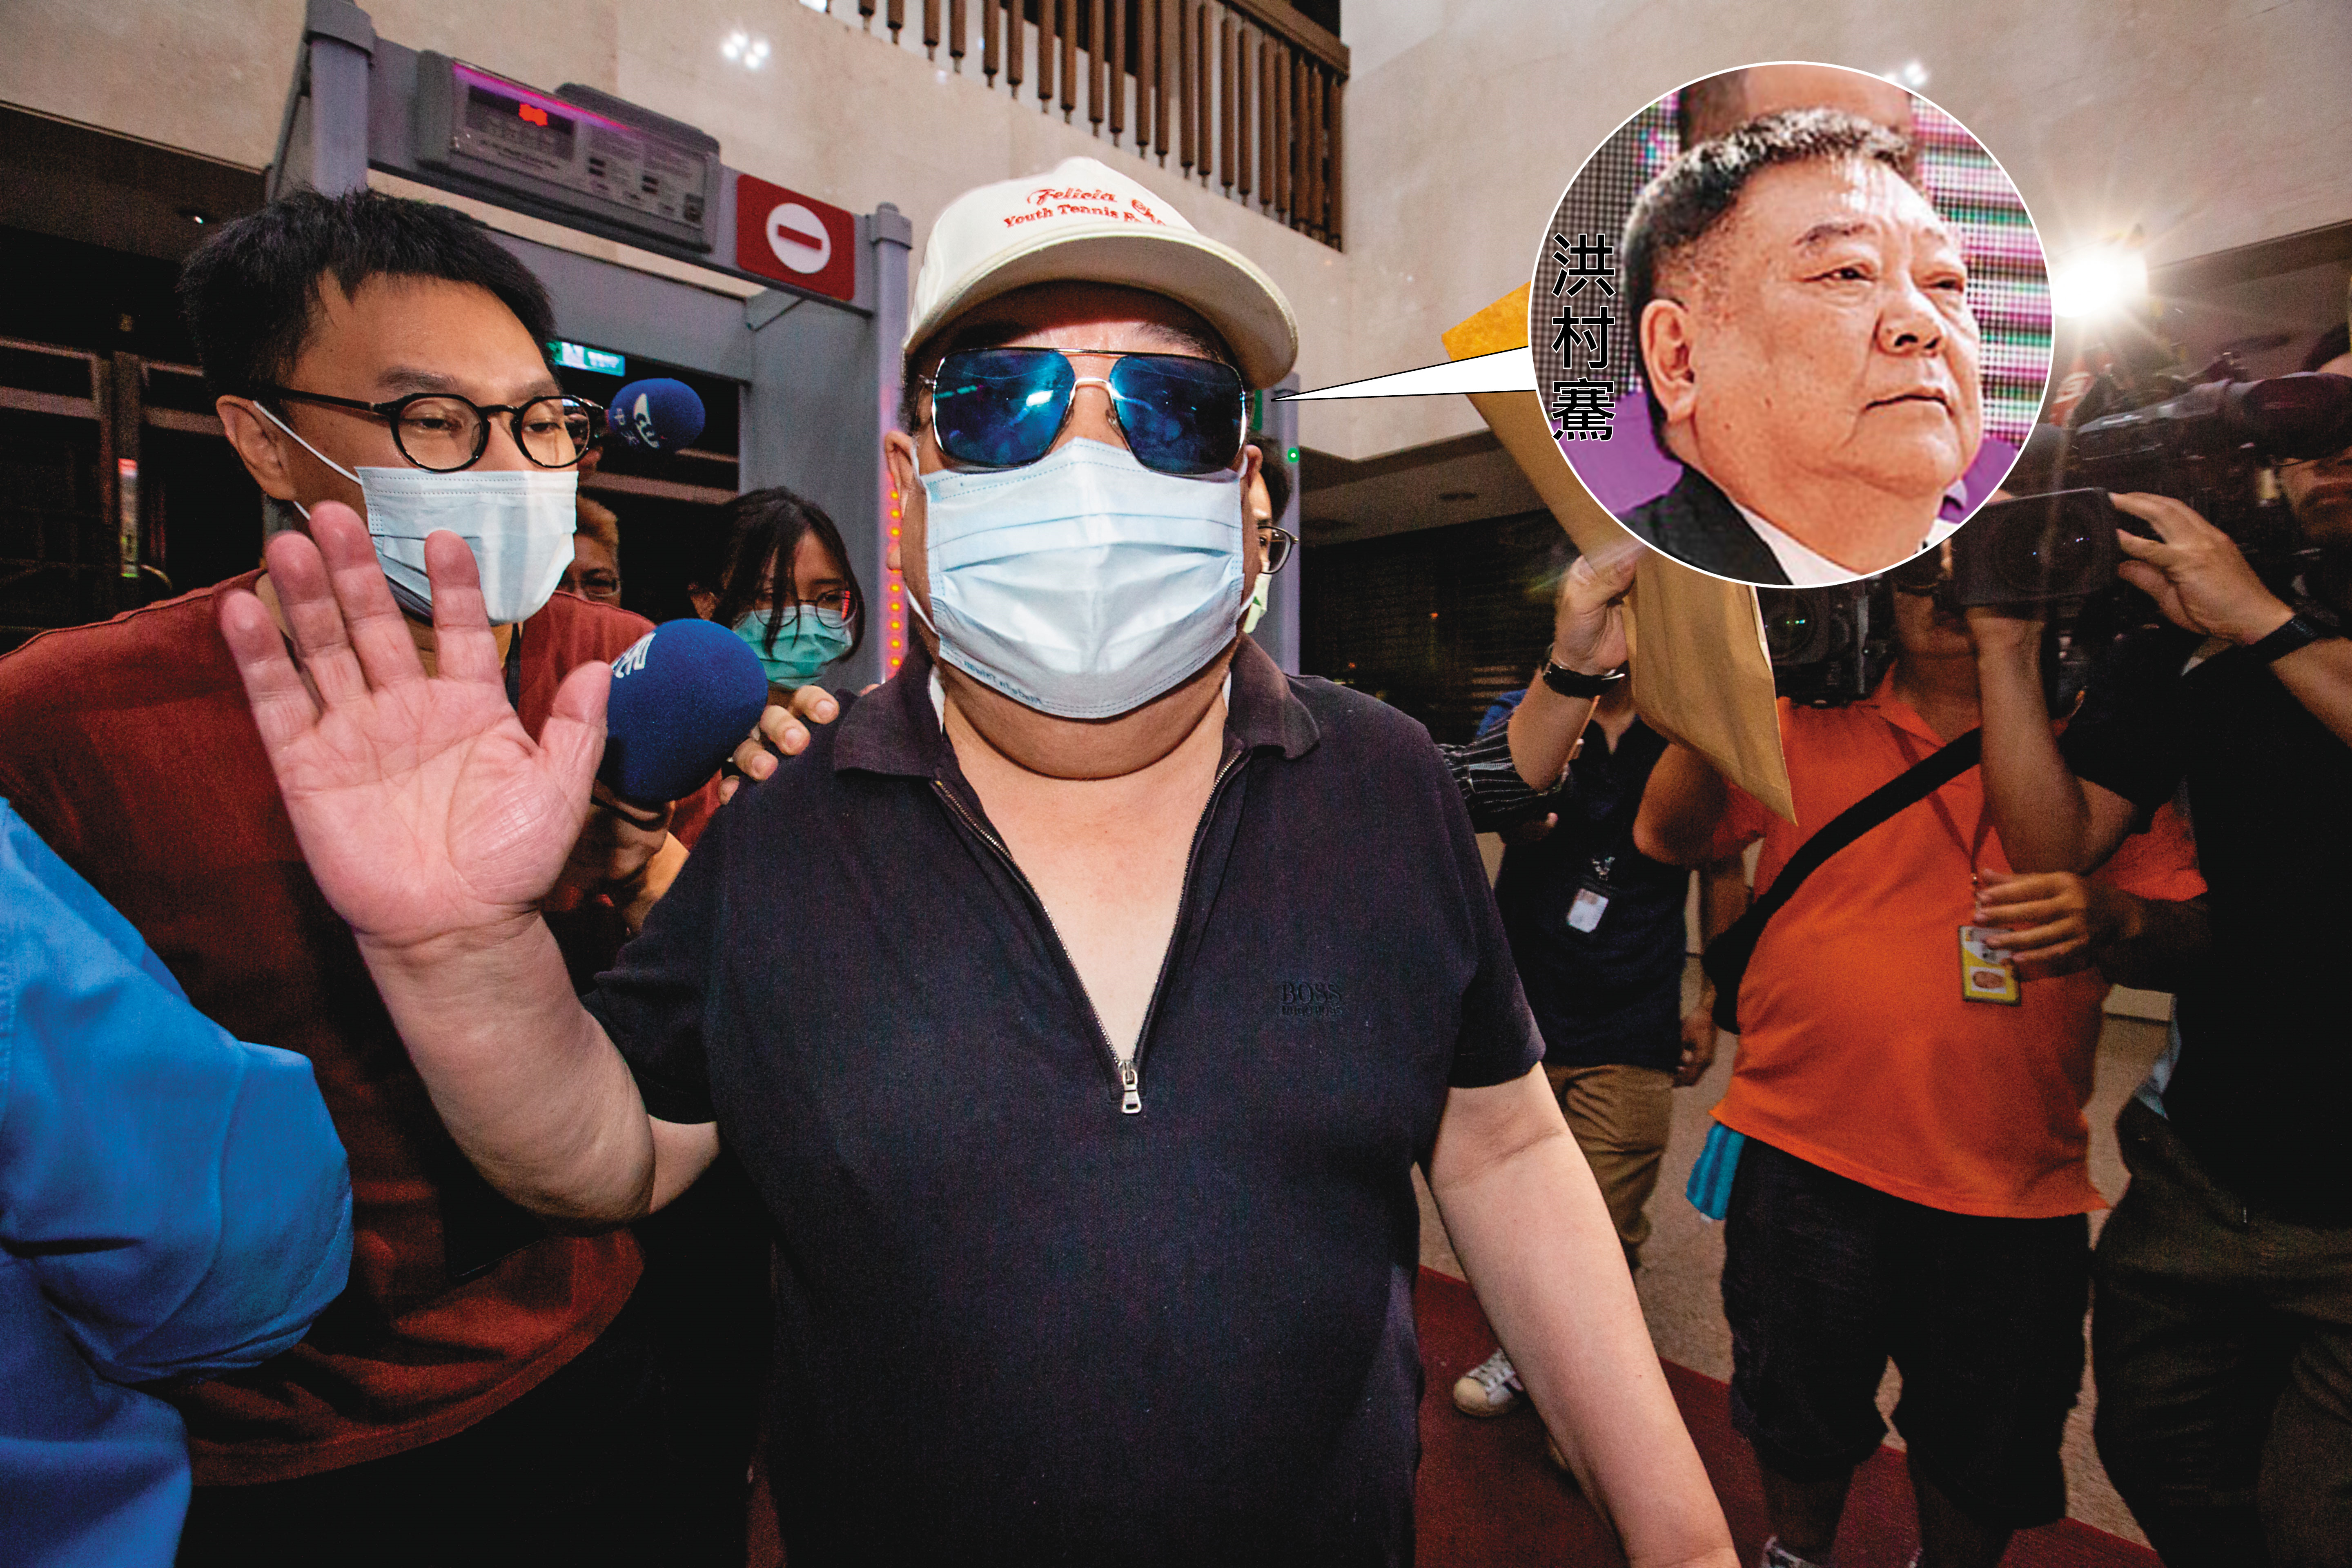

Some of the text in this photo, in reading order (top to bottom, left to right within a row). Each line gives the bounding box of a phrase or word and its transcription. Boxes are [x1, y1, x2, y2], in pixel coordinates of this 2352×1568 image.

[1027, 188, 1118, 205] Felicia
[1003, 207, 1054, 228] Youth
[1057, 204, 1119, 218] Tennis
[1281, 982, 1341, 1004] BOSS
